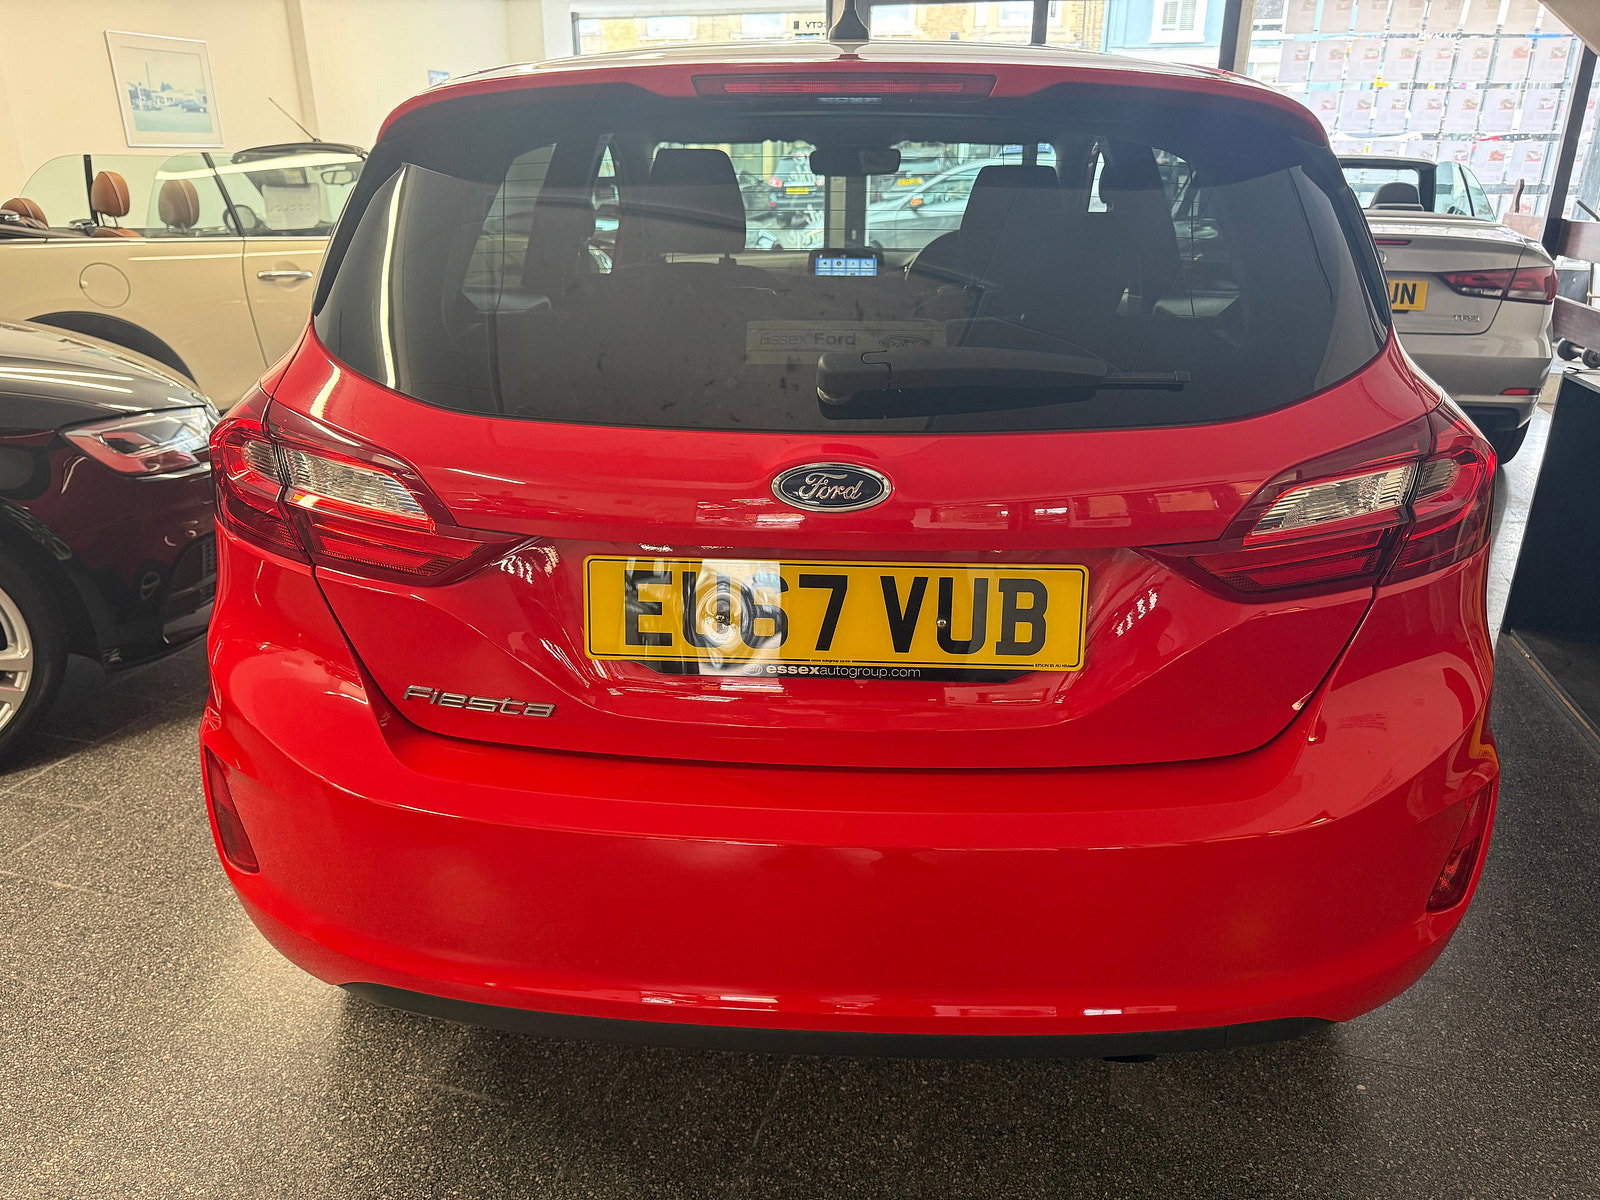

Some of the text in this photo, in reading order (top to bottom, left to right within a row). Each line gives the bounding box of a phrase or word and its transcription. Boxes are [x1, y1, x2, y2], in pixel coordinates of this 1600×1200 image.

[814, 332, 857, 346] Ford
[799, 472, 864, 500] Ford
[624, 570, 1049, 656] EU67 VUB
[765, 664, 921, 679] essexautogroup.com
[402, 684, 556, 718] Fiesta
